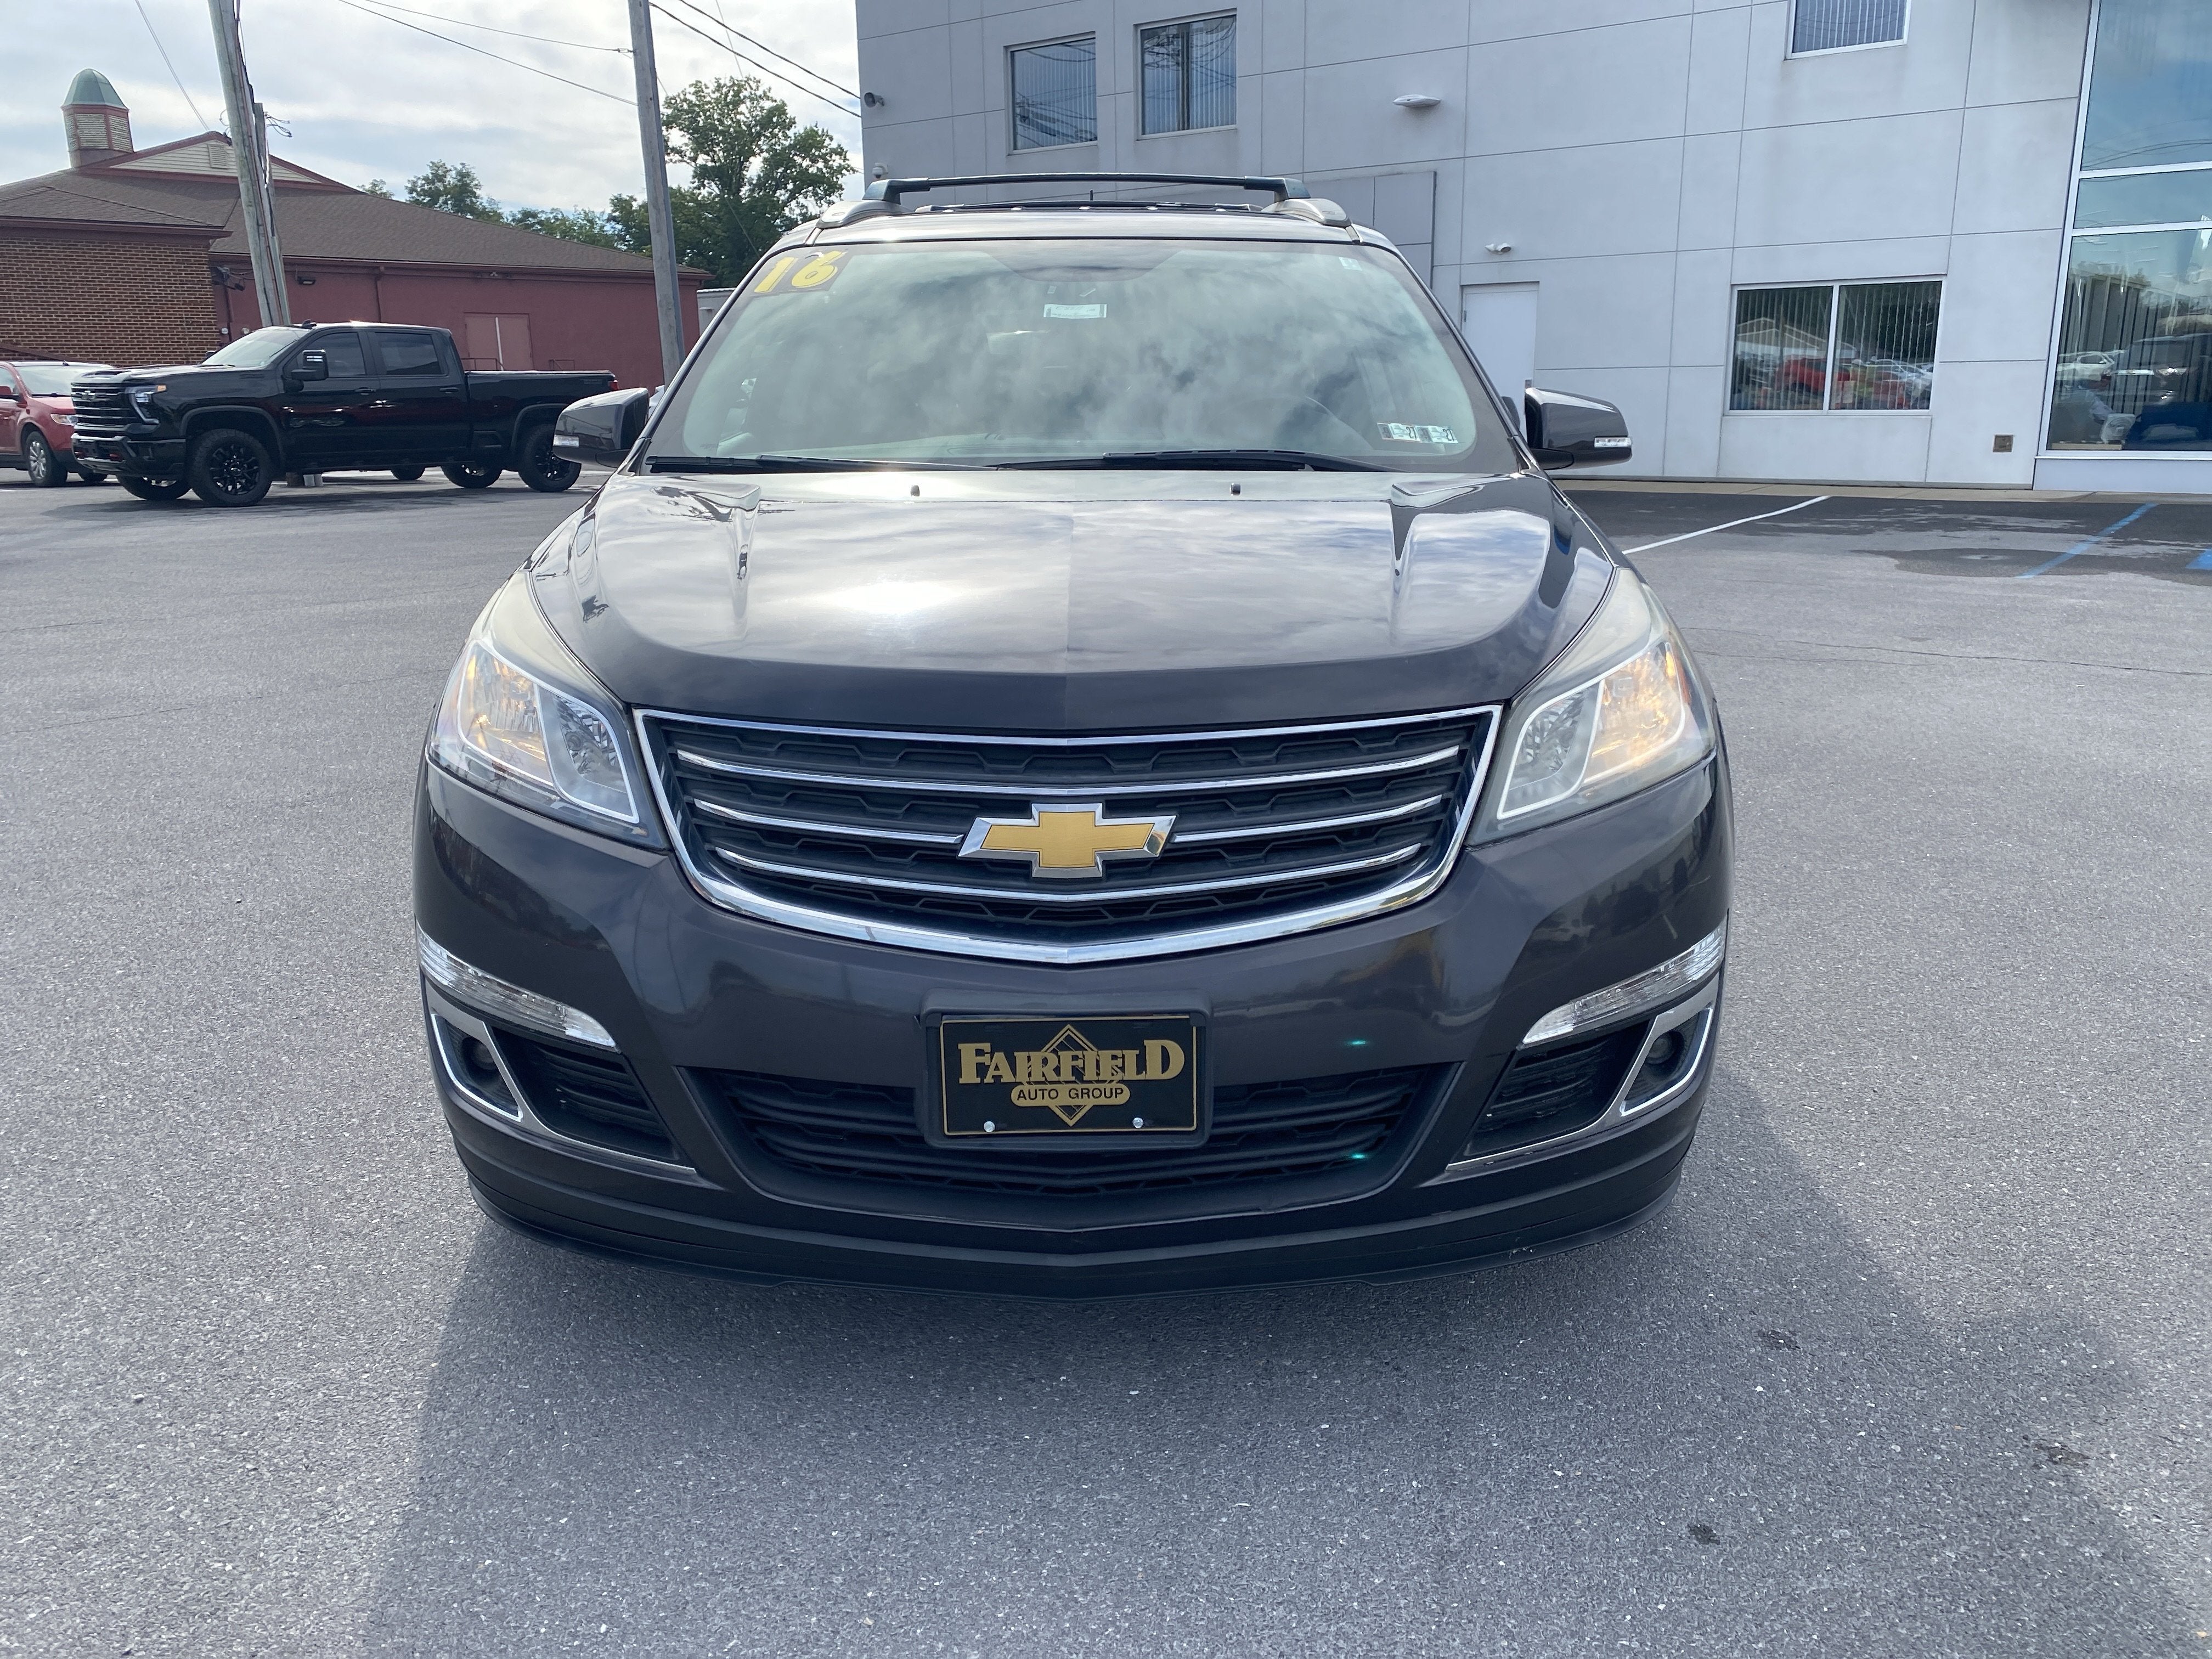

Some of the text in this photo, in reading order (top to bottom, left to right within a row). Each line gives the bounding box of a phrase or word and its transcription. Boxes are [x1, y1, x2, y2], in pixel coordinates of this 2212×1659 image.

[754, 250, 848, 293] 16
[958, 1039, 1185, 1084] FAIRFIELD
[1017, 1087, 1124, 1101] AUTO GROUP
